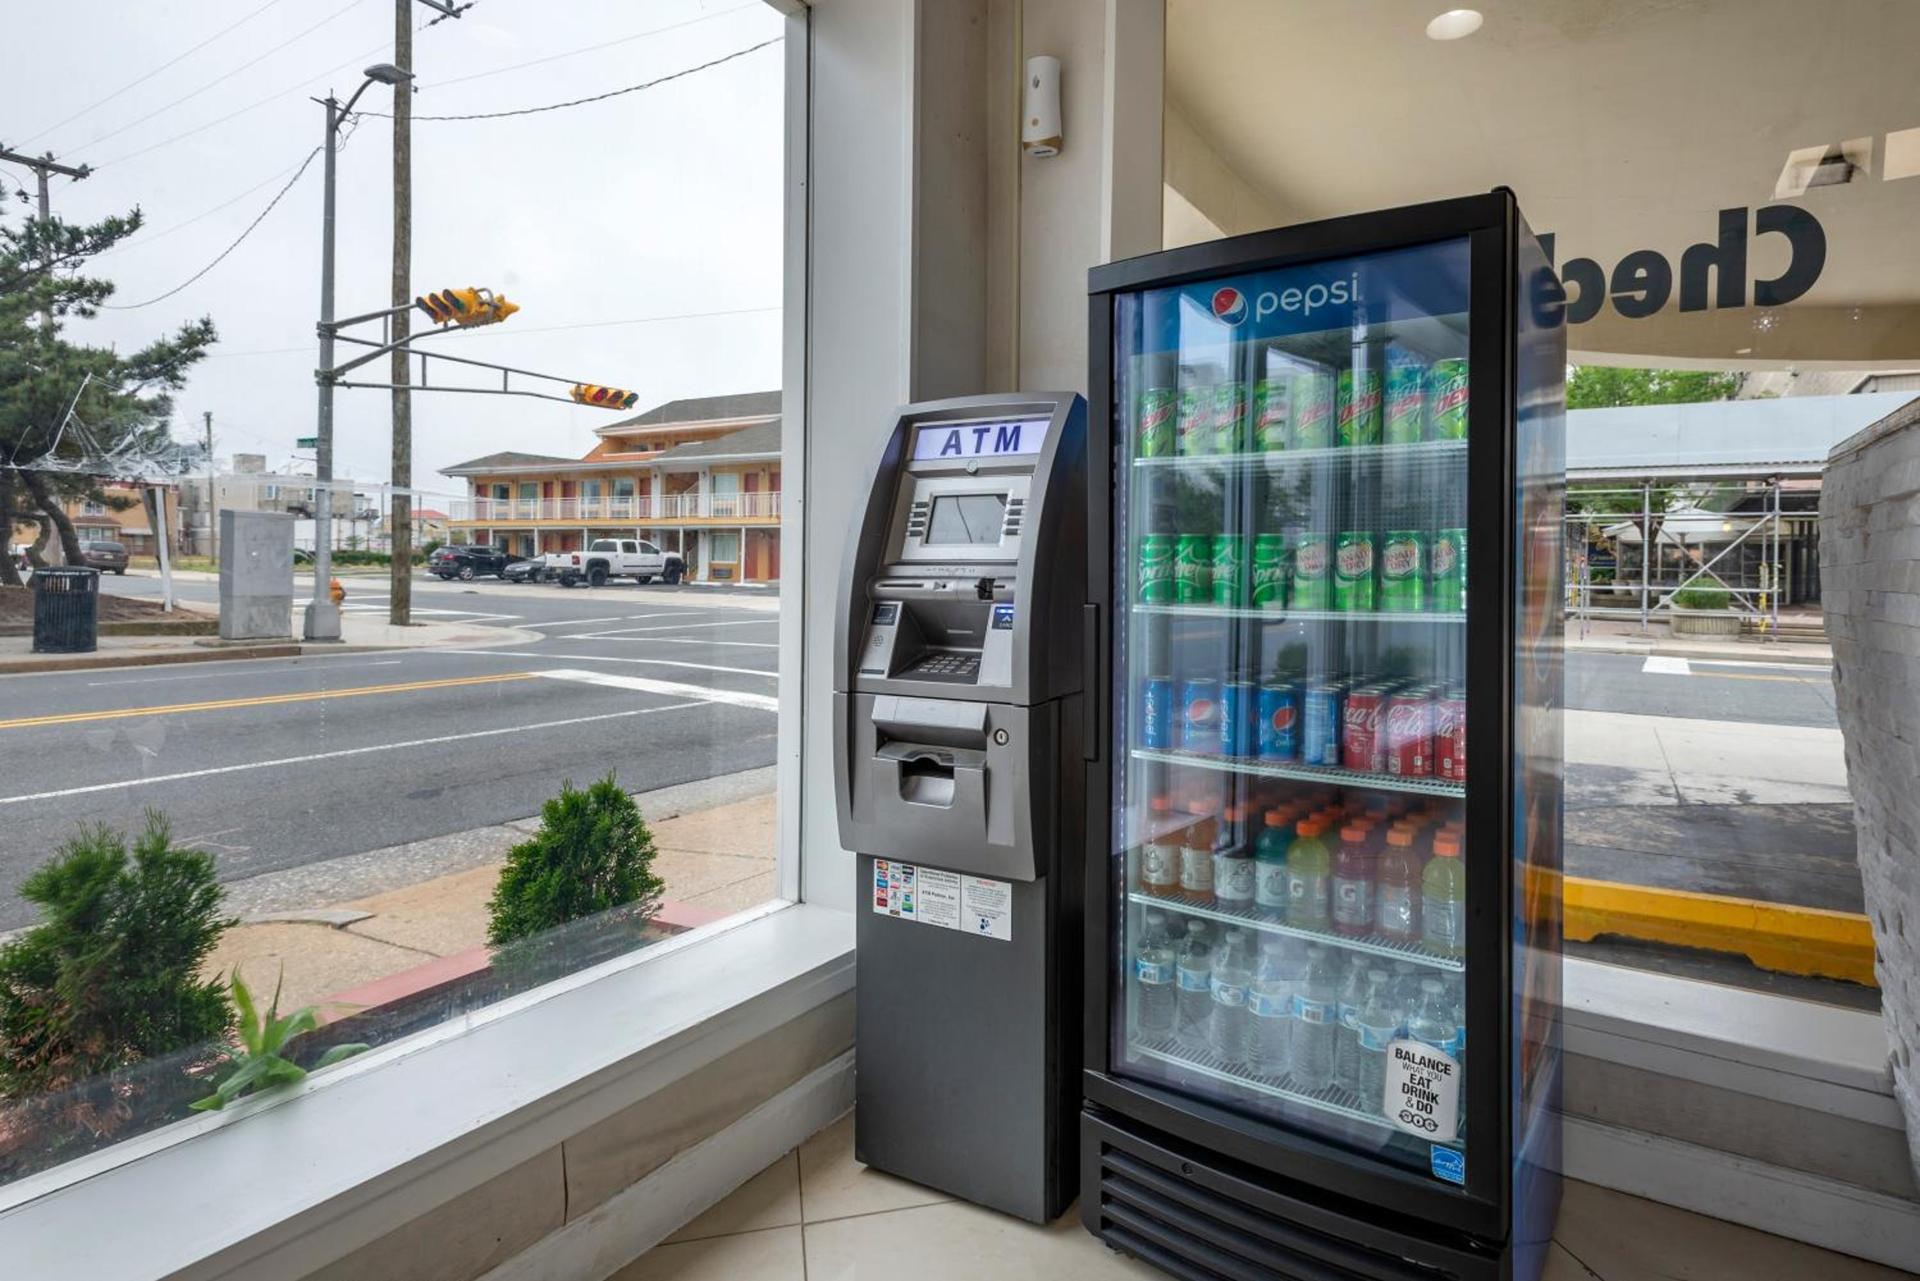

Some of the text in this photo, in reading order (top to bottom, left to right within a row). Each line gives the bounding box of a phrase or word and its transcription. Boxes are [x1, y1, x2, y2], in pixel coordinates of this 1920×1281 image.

[1256, 272, 1359, 323] pepsi
[940, 425, 1021, 456] ATM
[1394, 1047, 1452, 1076] BALANCE
[1402, 1061, 1442, 1082] WHAT YOU
[1409, 1073, 1433, 1090] EAT
[1401, 1082, 1440, 1106] DRINK
[1416, 1100, 1433, 1115] DO
